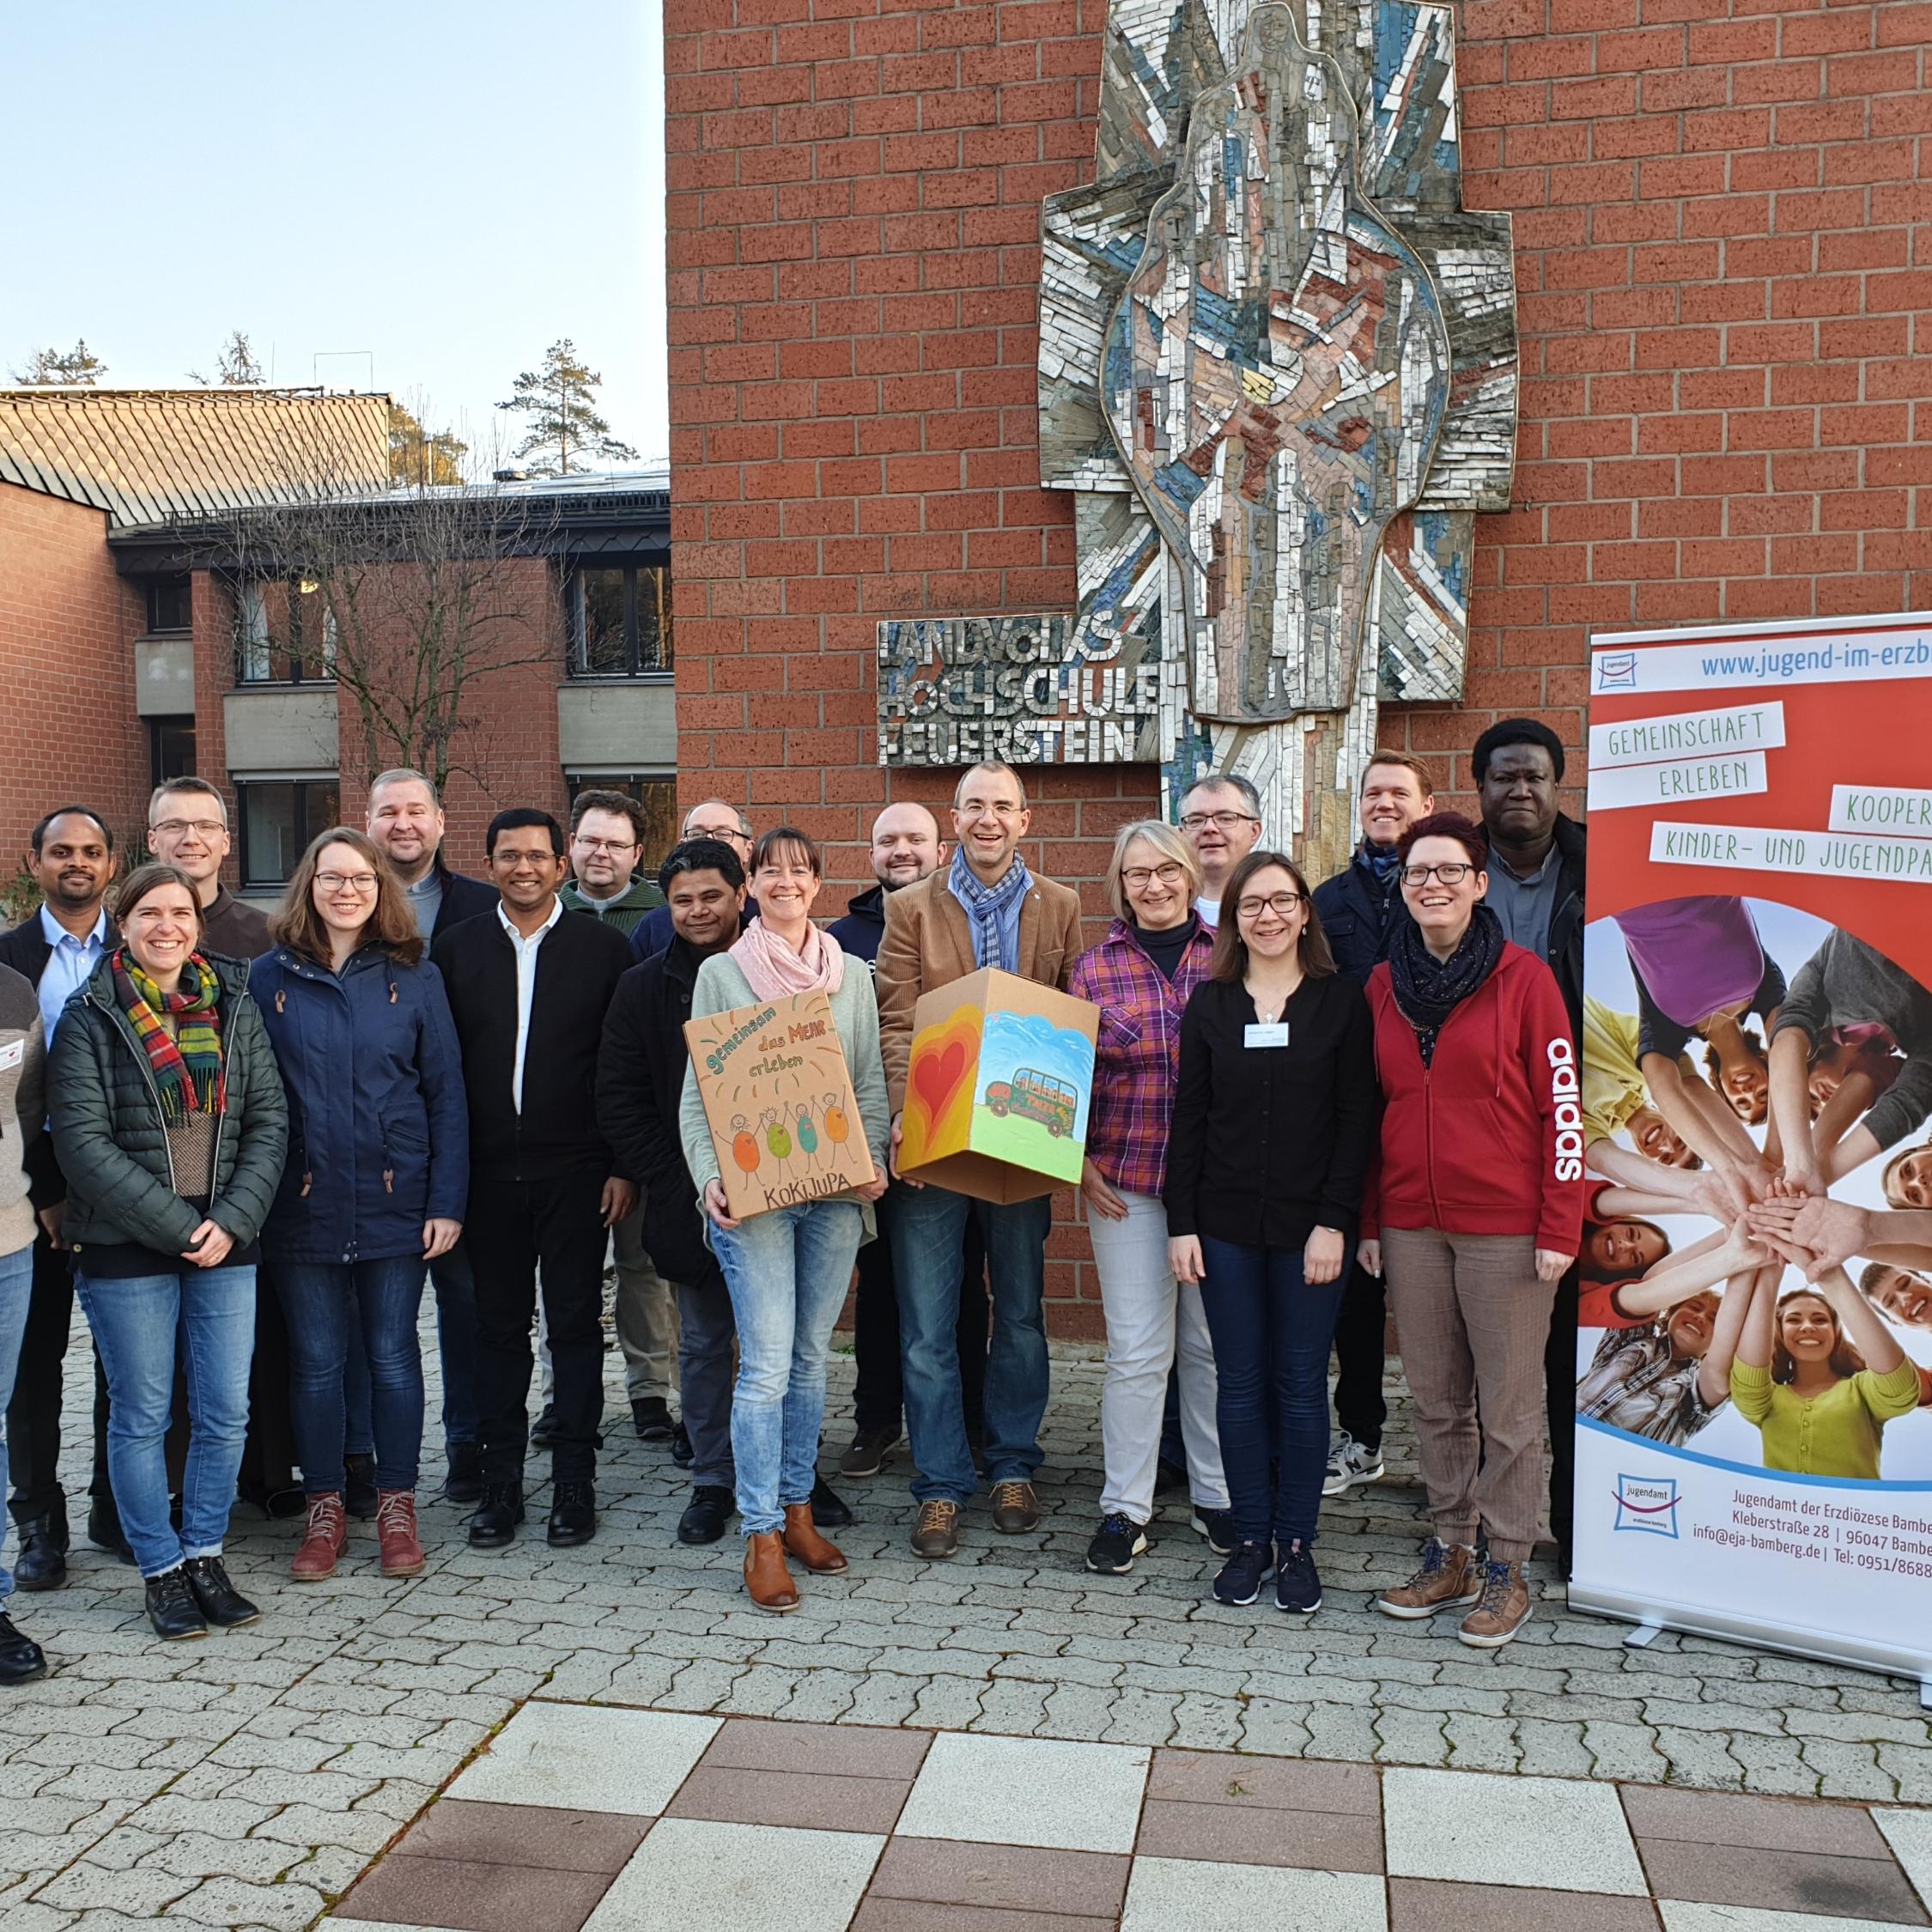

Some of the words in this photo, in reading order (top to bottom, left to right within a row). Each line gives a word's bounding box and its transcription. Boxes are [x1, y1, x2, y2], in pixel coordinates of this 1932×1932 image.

[1702, 638, 1932, 677] www.jugend-im-erzb
[879, 666, 1157, 717] HOCHSCHULE
[879, 720, 1134, 764] FEUERSTEIN
[1608, 712, 1764, 756] GEMEINSCHAFT
[1660, 762, 1748, 796] ERLEBEN
[1847, 793, 1931, 825] KOOPER
[1666, 830, 1753, 860] KINDER-
[1765, 837, 1805, 866] UND
[1820, 841, 1932, 876] JUGENDPA
[707, 1007, 776, 1075] gemeinsam
[758, 1036, 785, 1051] das
[787, 1020, 826, 1044] MEHR
[1547, 1038, 1584, 1182] adidas
[1626, 1484, 1668, 1500] jugendamt
[1732, 1489, 1797, 1513] Jugendamt
[1801, 1500, 1820, 1516] der
[1824, 1504, 1889, 1528] Erzdiözese
[1693, 1523, 1820, 1559] info@eja-bamberg.de
[1834, 1547, 1854, 1564] Tel:
[1857, 1554, 1932, 1578] 0951/8688
[1733, 1510, 1810, 1536] Kleberstraße
[1813, 1525, 1830, 1539] 28
[1846, 1530, 1888, 1550] 96047
